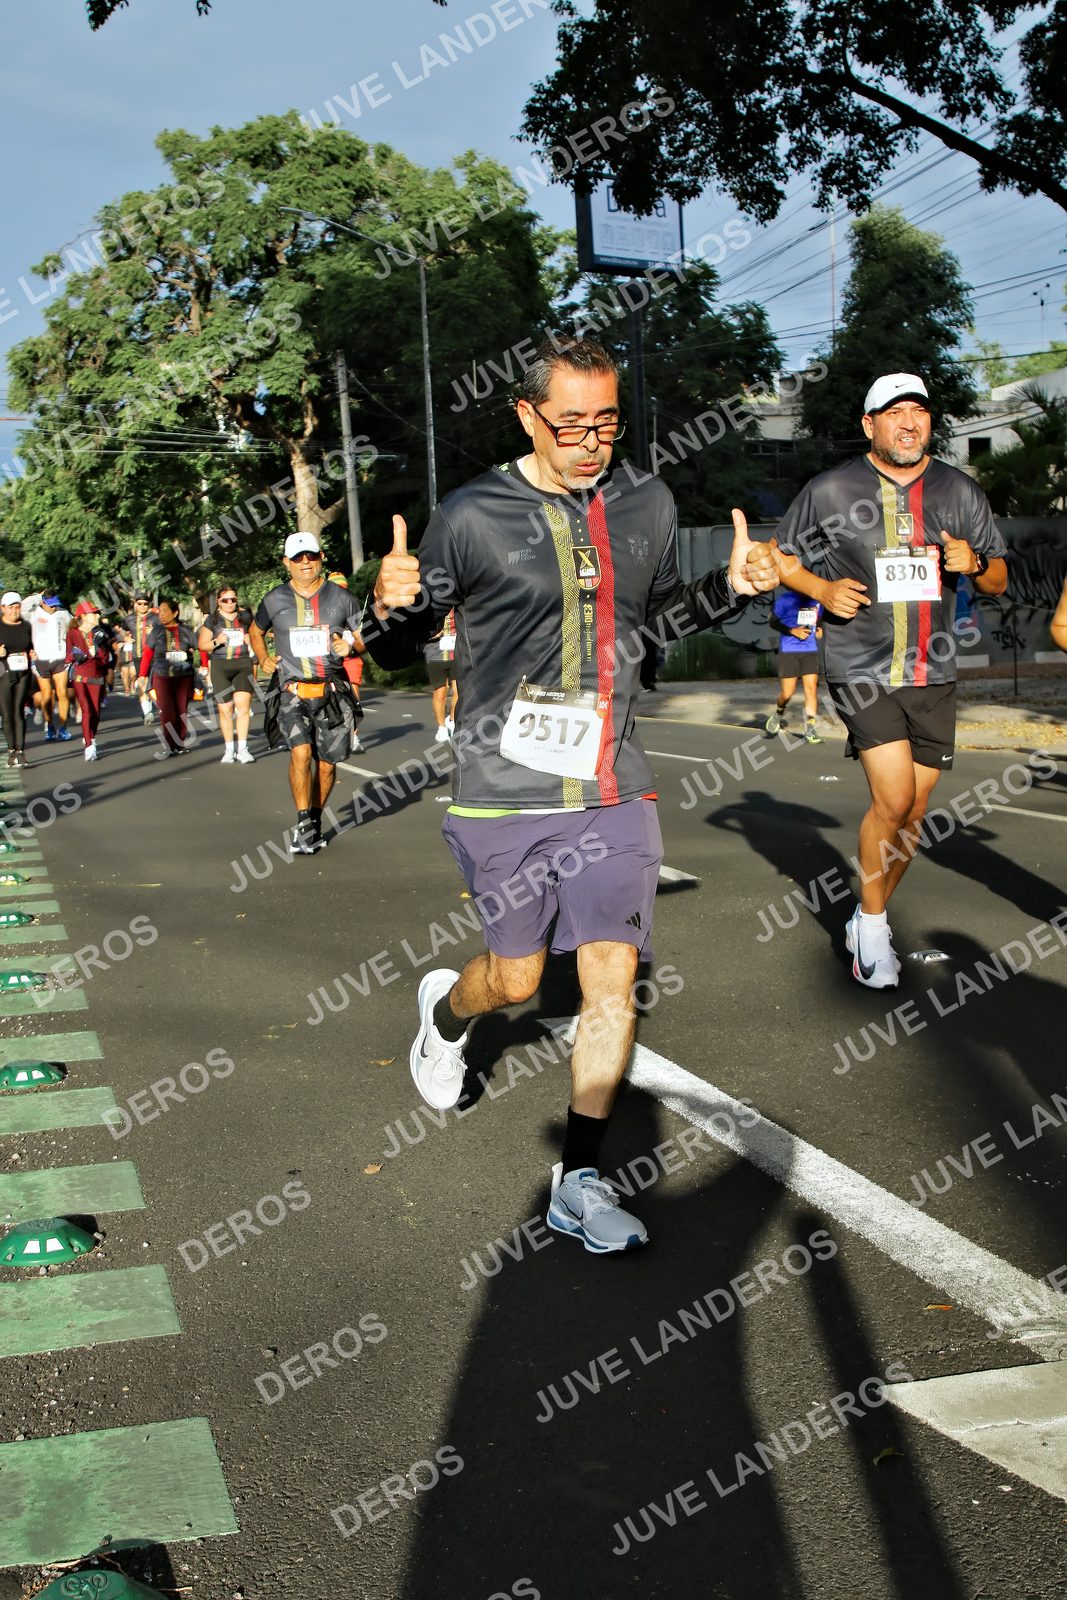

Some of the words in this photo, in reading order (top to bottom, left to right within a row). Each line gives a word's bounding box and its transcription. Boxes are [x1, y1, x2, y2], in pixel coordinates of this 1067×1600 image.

[886, 564, 927, 581] 8370
[295, 634, 321, 646] 8643
[518, 712, 591, 747] 9517
